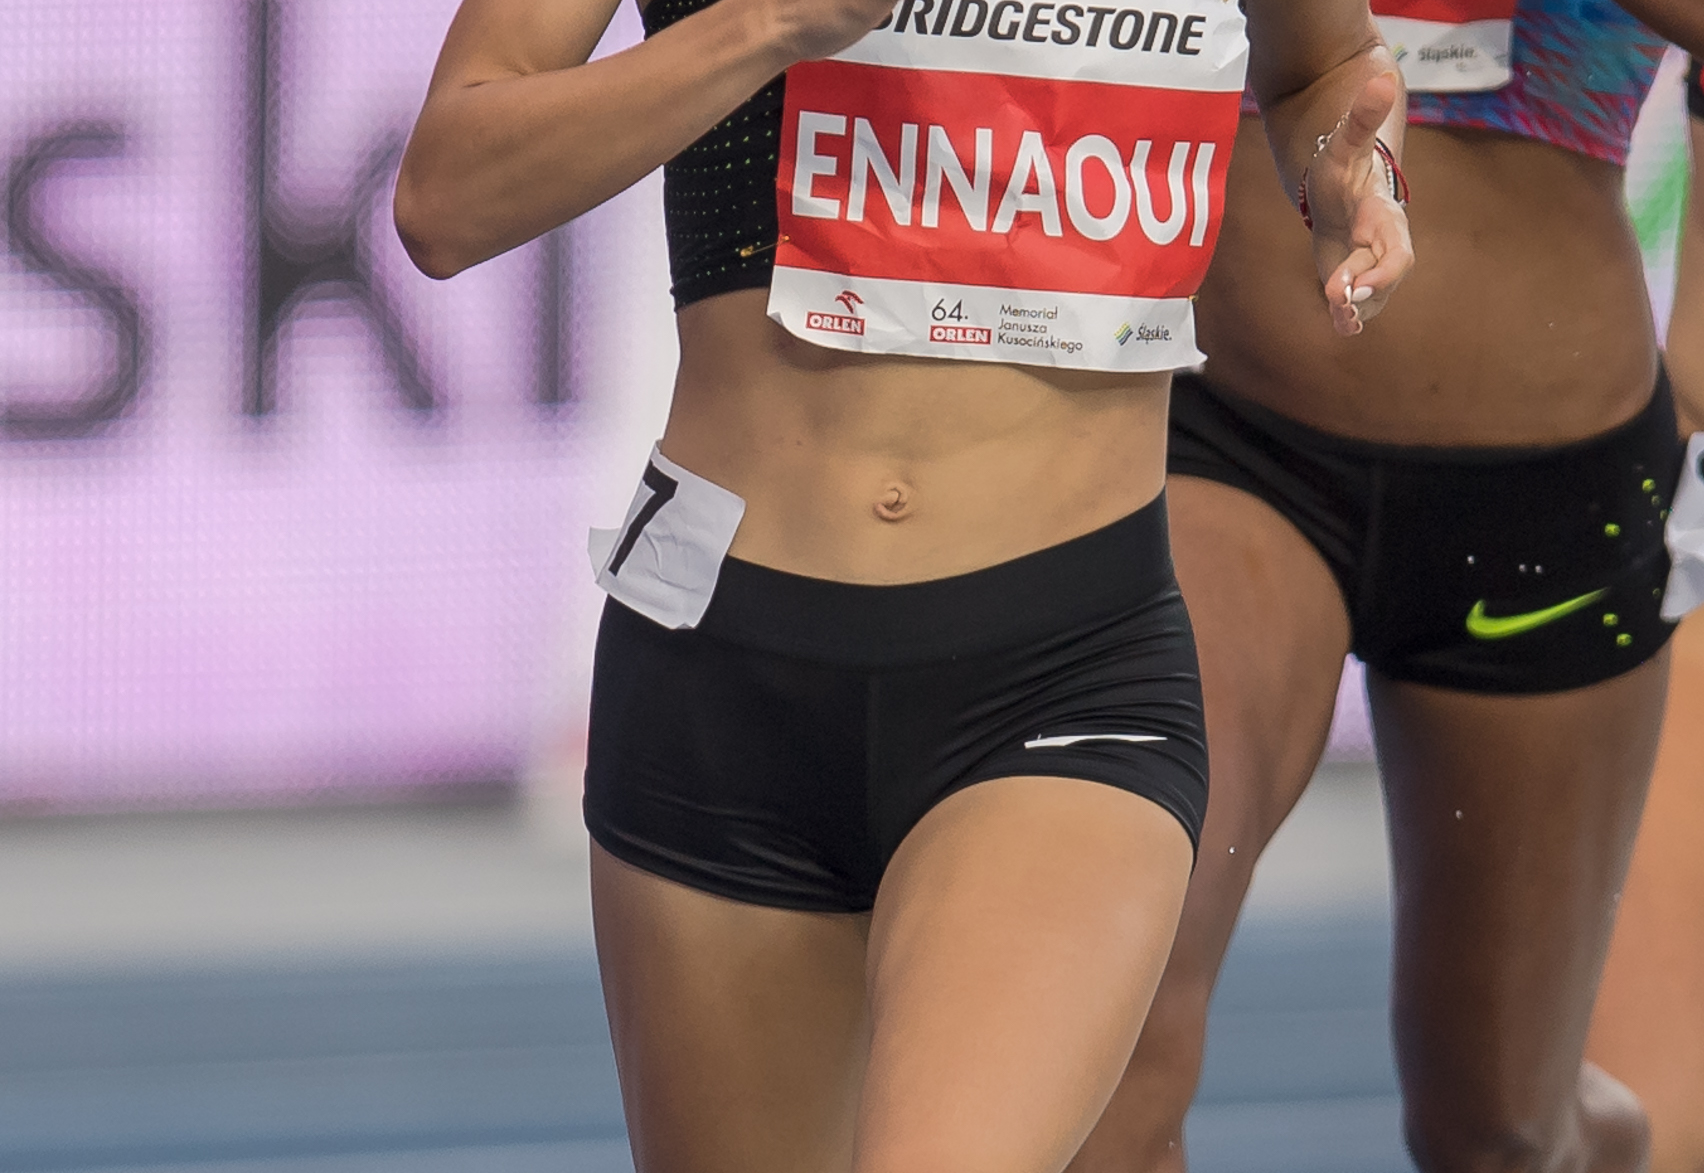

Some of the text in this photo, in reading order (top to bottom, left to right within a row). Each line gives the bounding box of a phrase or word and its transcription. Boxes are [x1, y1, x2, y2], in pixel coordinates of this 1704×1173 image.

[792, 110, 1215, 247] ENNAOUI
[931, 299, 969, 322] 64.
[808, 314, 863, 334] ORLEN
[931, 327, 989, 343] ORLEN
[997, 318, 1048, 333] Janusza
[997, 331, 1084, 354] Kusocińskiego
[608, 459, 679, 577] 7
